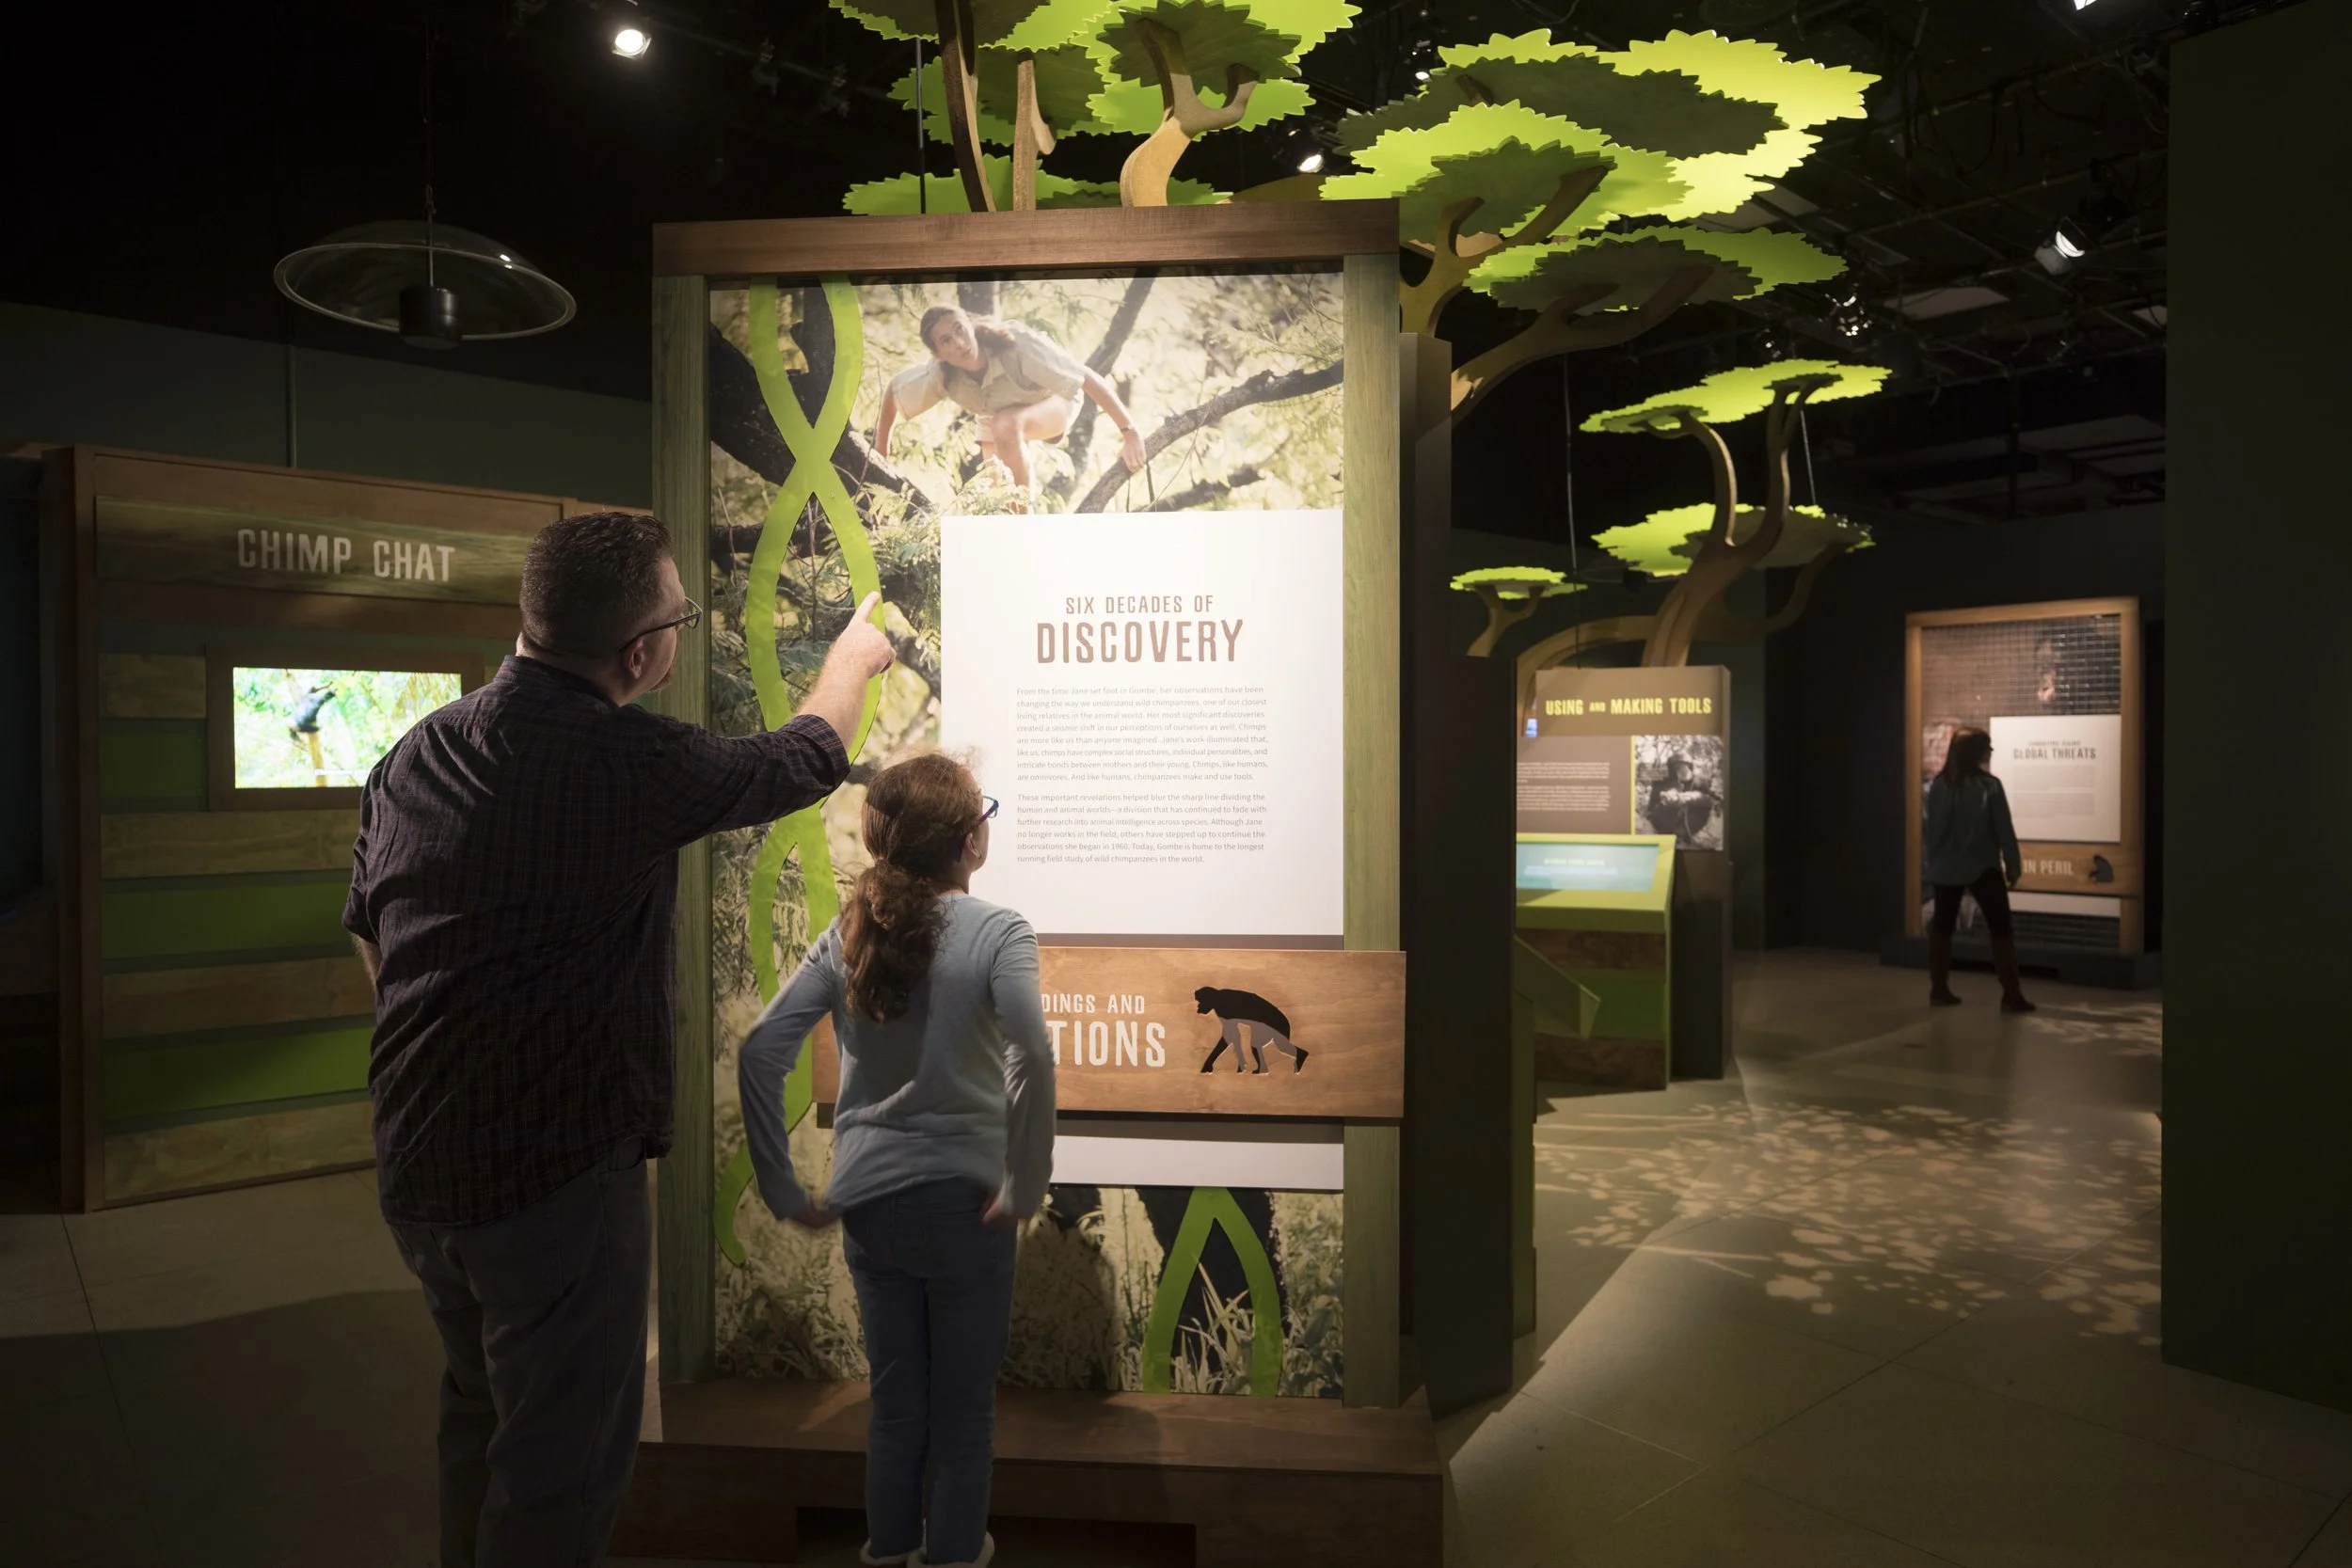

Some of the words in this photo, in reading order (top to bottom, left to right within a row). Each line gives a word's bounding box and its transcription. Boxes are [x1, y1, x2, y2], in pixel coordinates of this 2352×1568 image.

[238, 529, 352, 574] CHIMP
[373, 540, 455, 581] CHAT
[1066, 596, 1094, 614] SIX
[1105, 595, 1183, 613] DECADES
[1194, 594, 1214, 612] OF
[1037, 619, 1243, 663] DISCOVERY
[1244, 685, 1263, 693] been
[1016, 699, 1050, 708] changing
[1135, 698, 1152, 706] wild
[1546, 699, 1583, 716] USING
[1589, 702, 1606, 712] AND
[1611, 698, 1663, 715] MAKING
[1670, 697, 1712, 714] TOOLS
[1016, 711, 1038, 721] living
[1182, 710, 1221, 721] significant
[1016, 723, 1044, 732] created
[1238, 722, 1266, 732] Chimps
[1041, 748, 1066, 758] chimps
[1066, 748, 1084, 756] have
[1084, 748, 1113, 757] complex
[2013, 747, 2048, 760] GLOBAL
[2052, 747, 2096, 760] THREATS
[1016, 760, 1047, 768] intricate
[1047, 760, 1070, 768] bonds
[1071, 760, 1102, 768] between
[1071, 772, 1086, 781] And
[1087, 772, 1101, 781] like
[1133, 772, 1182, 782] chimpanzees
[1183, 772, 1203, 781] make
[1041, 793, 1078, 802] important
[1122, 793, 1150, 802] helped
[1181, 793, 1204, 802] sharp
[1220, 793, 1251, 802] dividing
[1089, 817, 1115, 826] animal
[1115, 817, 1156, 827] intelligence
[1210, 817, 1244, 828] Although
[1245, 817, 1263, 826] Jane
[1027, 830, 1053, 839] longer
[1120, 830, 1145, 838] others
[1145, 830, 1164, 838] have
[1165, 830, 1196, 839] stepped
[1208, 830, 1217, 838] to
[1217, 830, 1252, 838] continue
[1252, 830, 1265, 838] the
[1017, 842, 1064, 850] observations
[1064, 842, 1078, 850] she
[1078, 842, 1102, 852] began
[1102, 842, 1110, 850] in
[1237, 843, 1264, 852] longest
[1017, 854, 1046, 864] running
[1046, 854, 1063, 863] field
[1063, 854, 1085, 863] study
[1085, 854, 1093, 863] of
[1093, 854, 1110, 863] wild
[1110, 854, 1158, 863] chimpanzees
[1159, 854, 1167, 863] in
[1168, 854, 1181, 863] the
[2040, 860, 2074, 876] PERIL
[1041, 993, 1096, 1014] DINGS
[1106, 994, 1145, 1015] AND
[1045, 1020, 1166, 1068] TIONS
